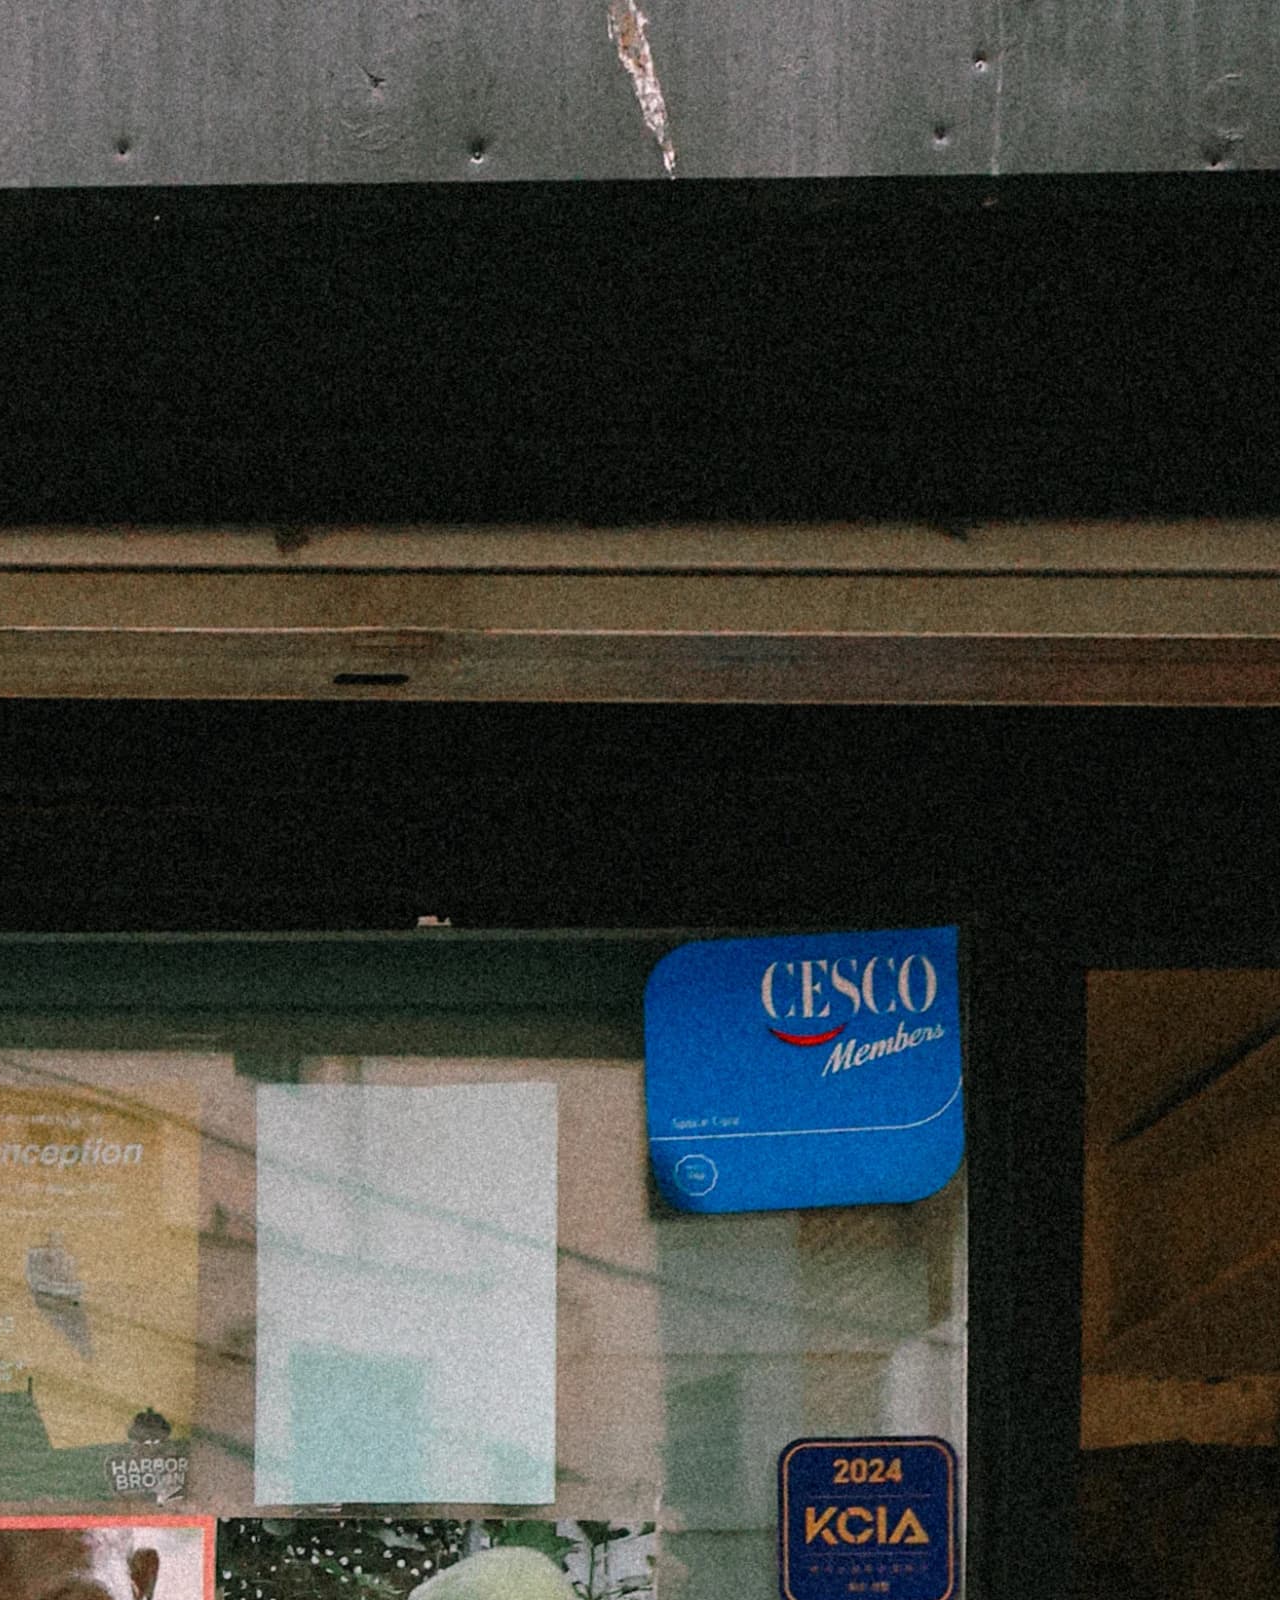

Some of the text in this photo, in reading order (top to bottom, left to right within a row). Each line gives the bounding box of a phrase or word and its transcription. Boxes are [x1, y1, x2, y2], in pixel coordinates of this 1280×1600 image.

[761, 954, 937, 1019] CESCO
[822, 1021, 945, 1077] Members
[111, 1457, 189, 1475] HARBOR
[833, 1458, 903, 1484] 2024
[805, 1506, 929, 1545] KCIA
